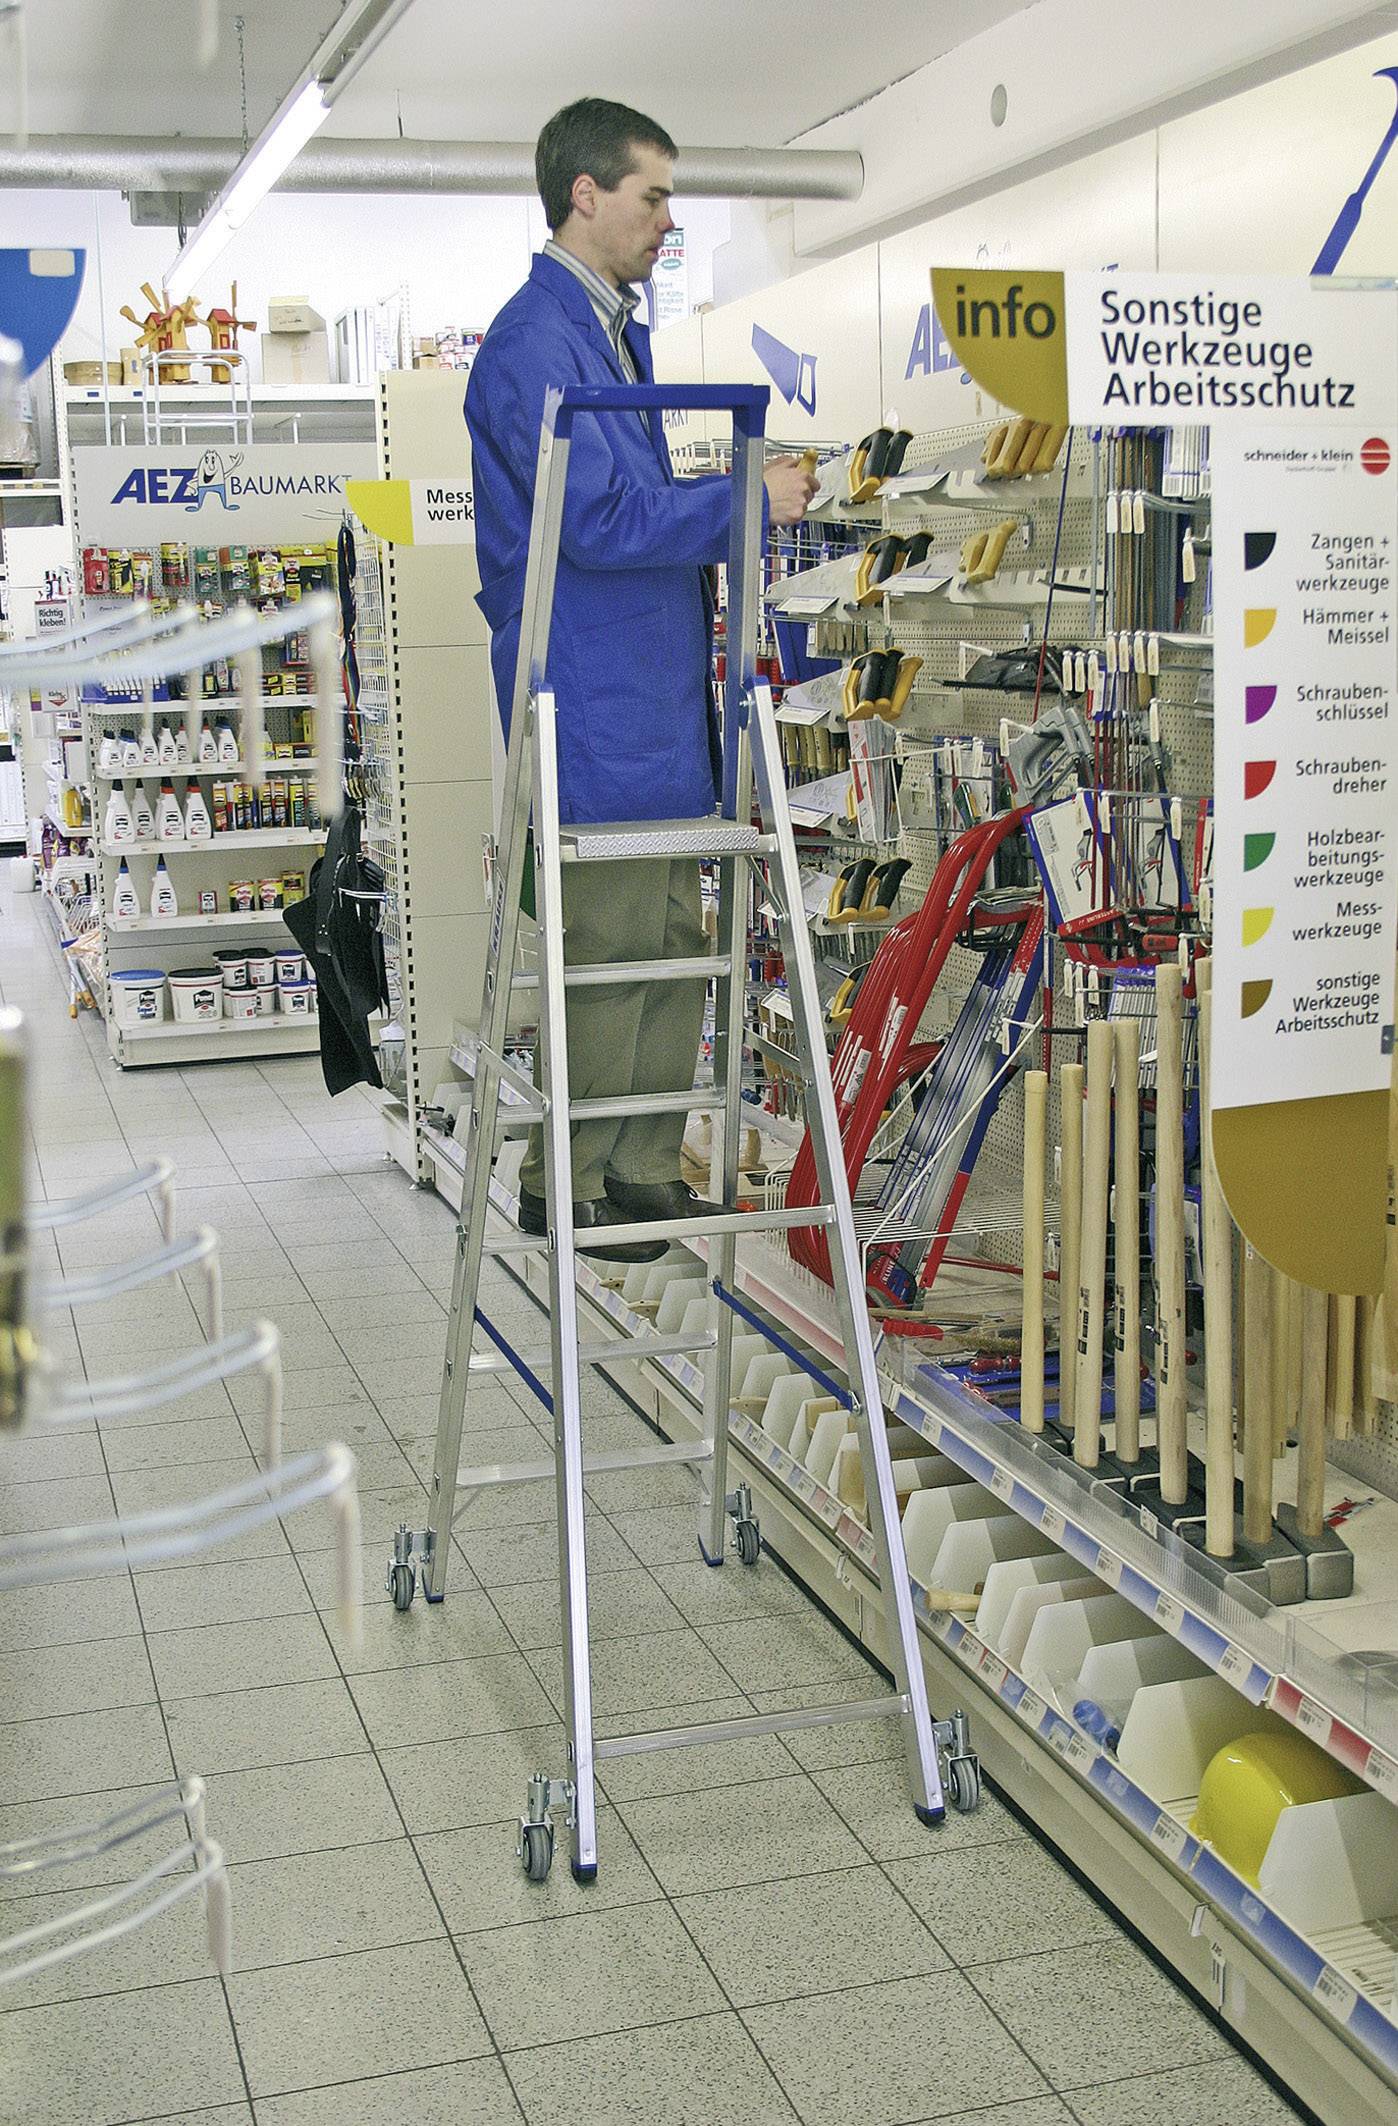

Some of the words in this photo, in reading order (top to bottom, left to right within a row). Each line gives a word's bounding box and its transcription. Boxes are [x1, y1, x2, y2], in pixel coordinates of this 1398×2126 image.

[956, 285, 1056, 339] info
[1101, 290, 1262, 336] Sonstige
[905, 302, 960, 380] AE
[1102, 332, 1313, 376] Werkzeuge
[1103, 371, 1356, 409] Arbeitsschutz
[1243, 449, 1309, 462] schneider
[1321, 449, 1354, 462] klein
[110, 468, 199, 504] AEZ
[1310, 533, 1374, 552] Zangen
[1380, 538, 1390, 548] +
[1325, 553, 1390, 570] Sanitär-
[1296, 574, 1390, 594] werkzeuge
[1302, 608, 1374, 625] Hämmer
[1380, 612, 1390, 622] +
[1327, 627, 1389, 645] Meissel
[1296, 683, 1389, 702] Schrauben-
[1316, 702, 1389, 722] schlüssel
[1295, 757, 1387, 776] Schrauben-
[1332, 777, 1387, 795] dreher
[1307, 829, 1385, 847] Holzbear-
[1307, 849, 1385, 868] beitungs-
[1294, 868, 1385, 888] werkzeuge
[1336, 902, 1383, 918] Mess-
[1292, 920, 1382, 942] werkzeuge
[1316, 972, 1380, 991] sonstige
[1292, 992, 1380, 1013] Werkzeuge
[1275, 1011, 1379, 1034] Arbeitsschutz
